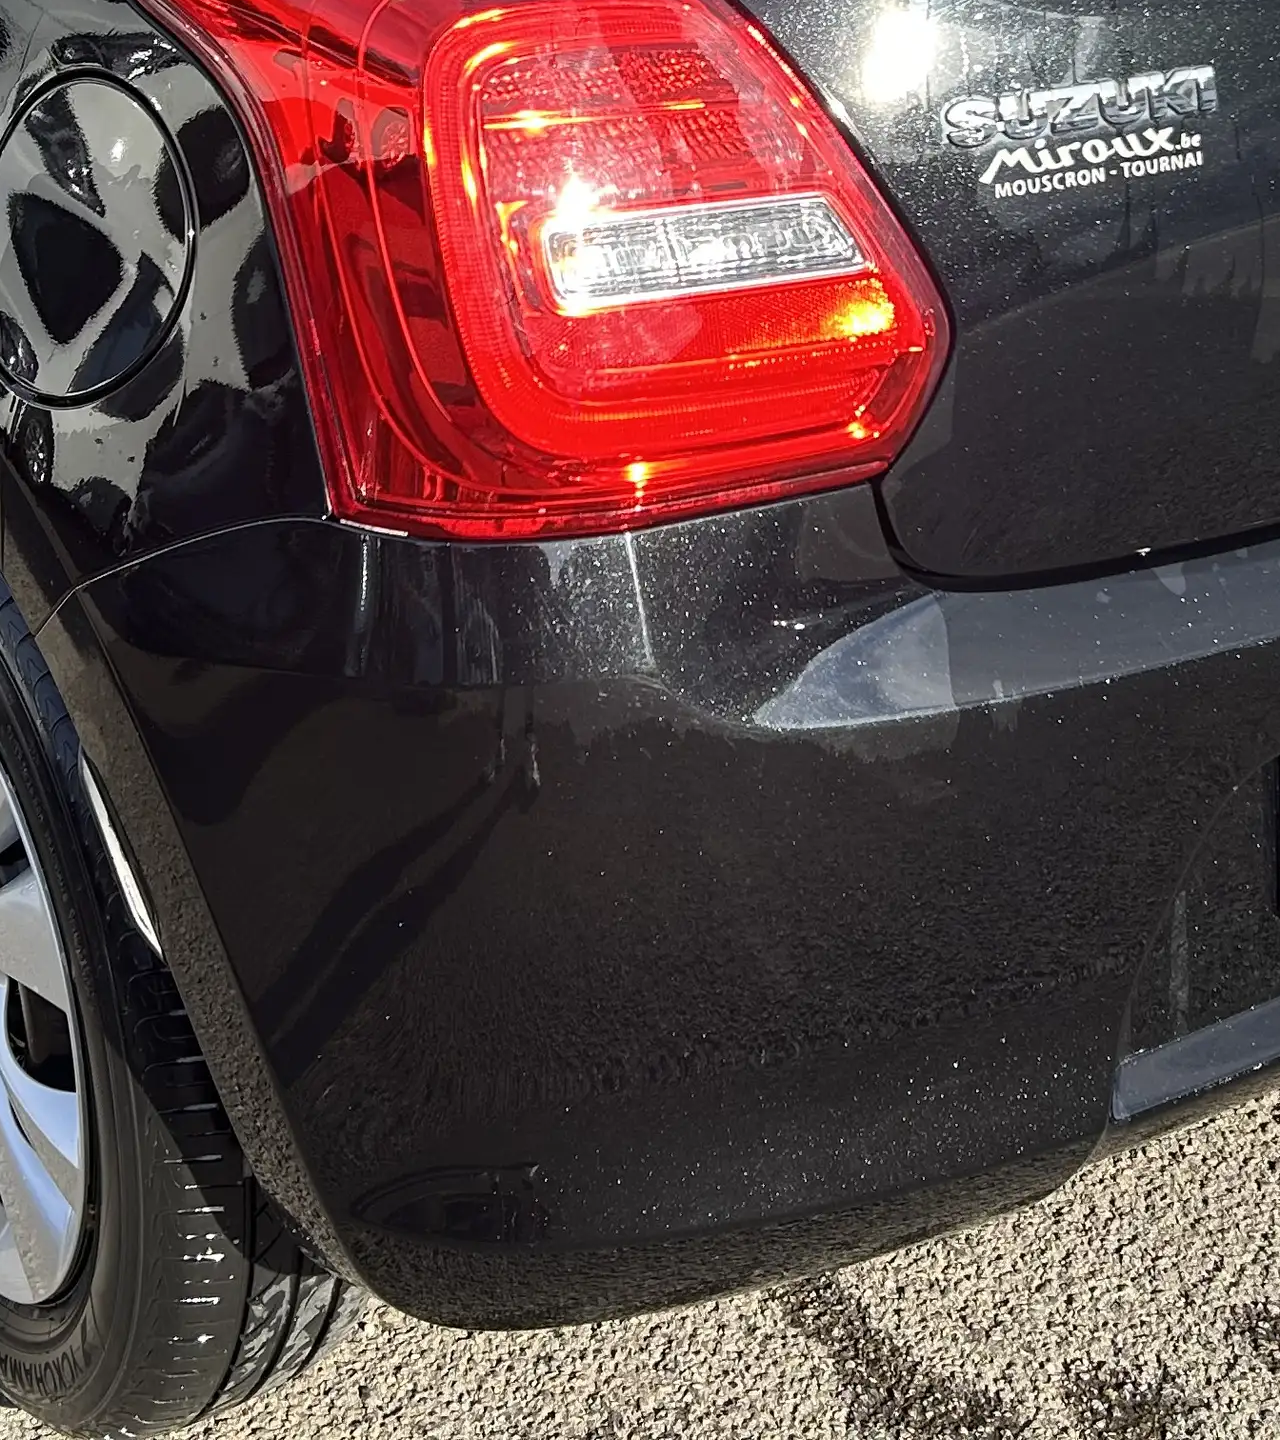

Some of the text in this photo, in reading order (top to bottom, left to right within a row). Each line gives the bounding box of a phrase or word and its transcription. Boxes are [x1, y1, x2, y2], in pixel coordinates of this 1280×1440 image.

[941, 65, 1218, 148] SUZUKI
[994, 166, 1107, 199] MOUSCRON
[1120, 150, 1204, 180] TOURNAI
